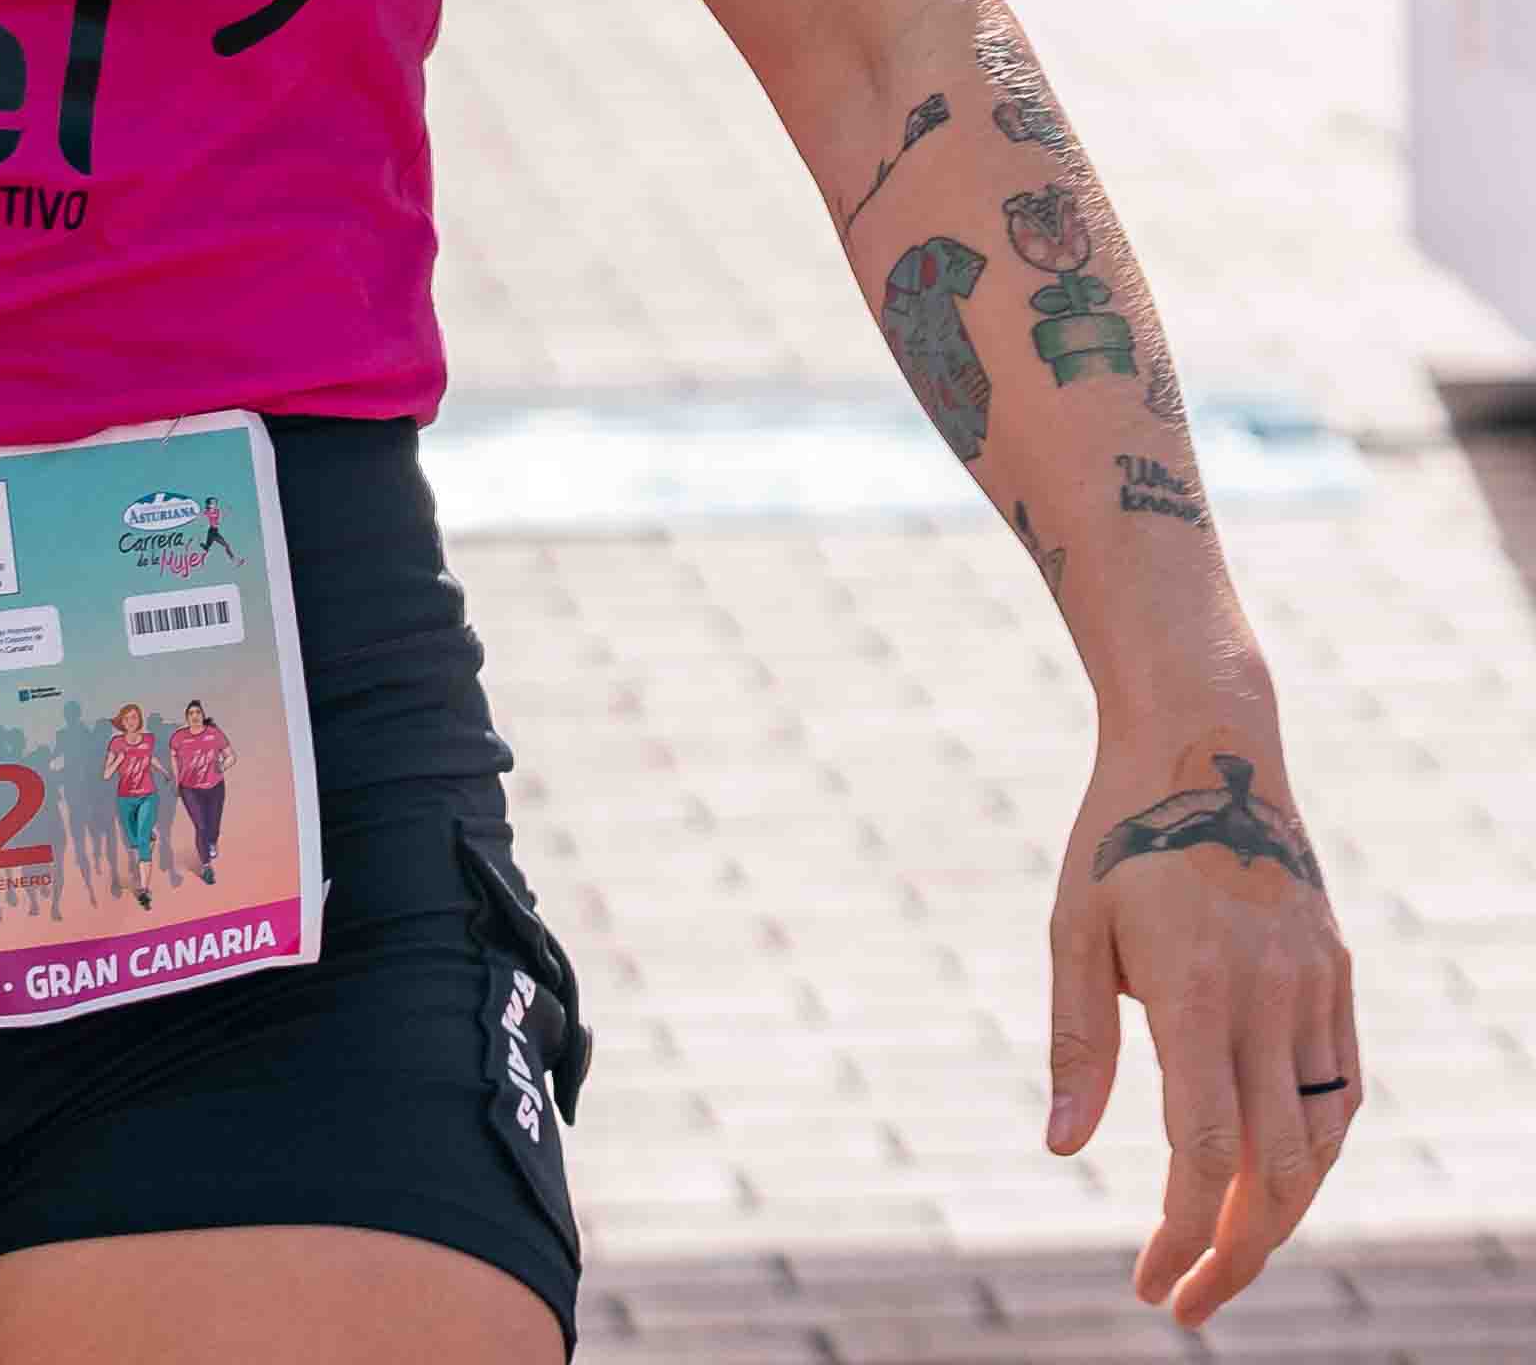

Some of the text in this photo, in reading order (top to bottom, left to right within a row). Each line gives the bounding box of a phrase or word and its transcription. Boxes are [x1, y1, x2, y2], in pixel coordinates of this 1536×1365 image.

[128, 506, 196, 525] ASTURIANA
[118, 531, 185, 554] Carrera
[159, 547, 208, 578] Mujer
[25, 953, 118, 1001] GRAN
[128, 919, 278, 979] CANARIA
